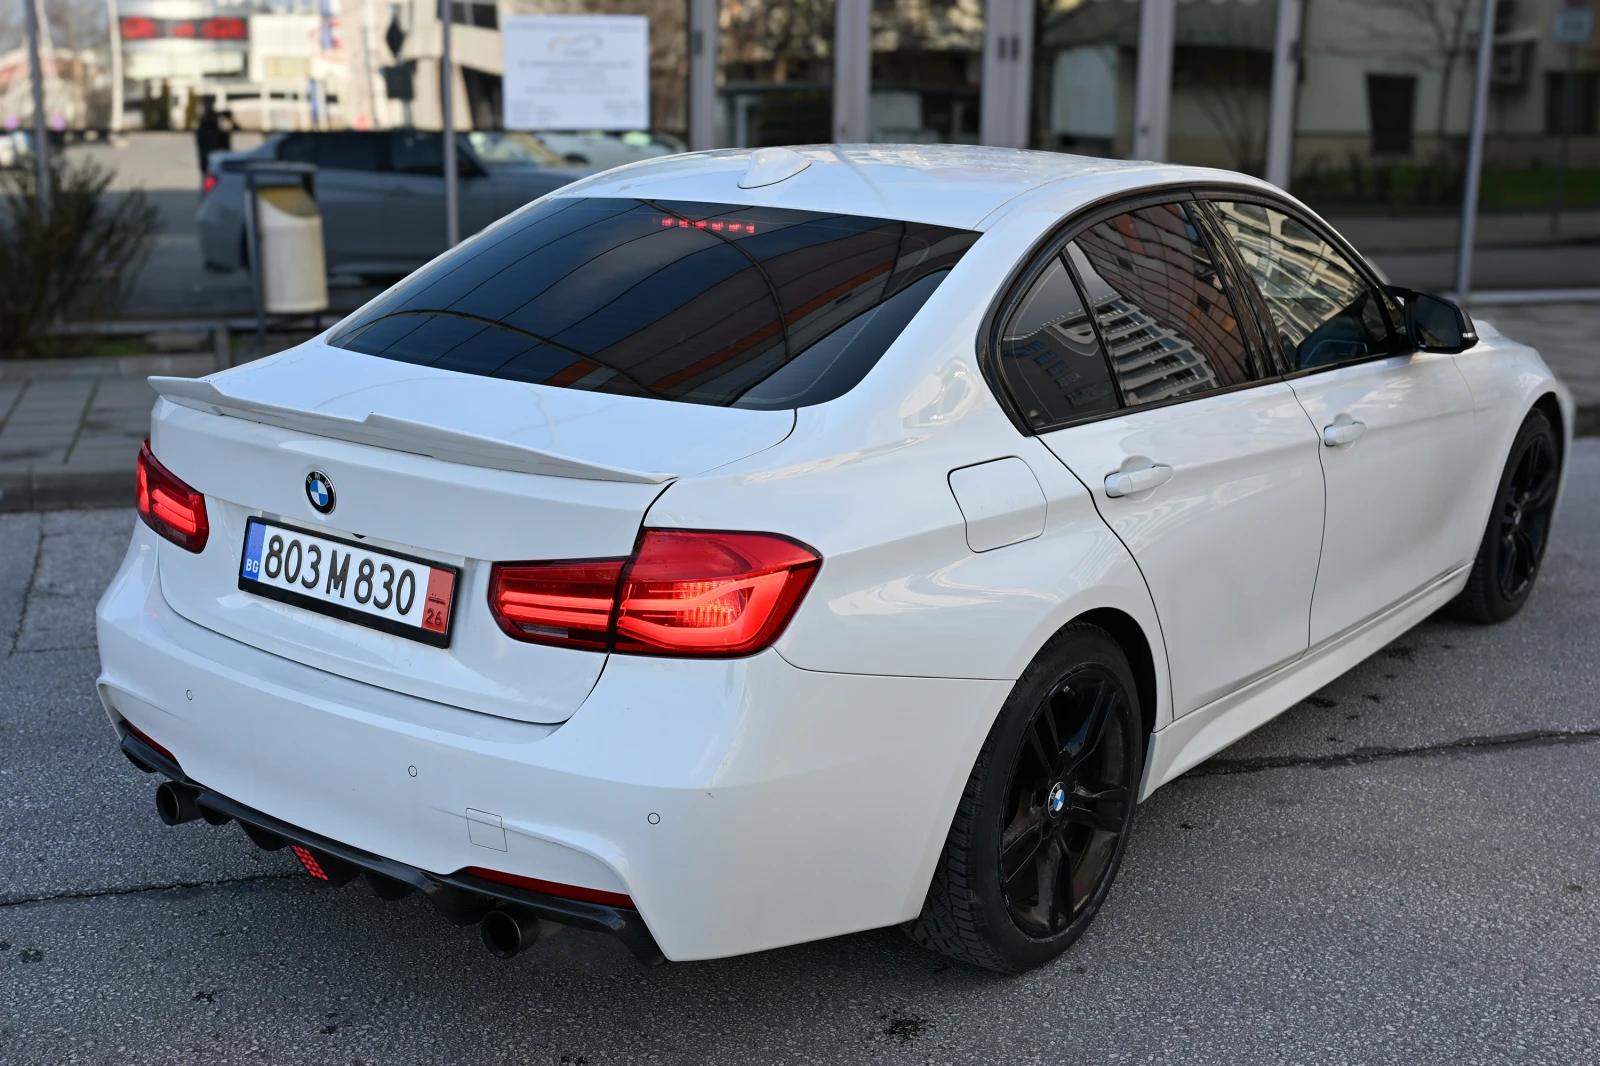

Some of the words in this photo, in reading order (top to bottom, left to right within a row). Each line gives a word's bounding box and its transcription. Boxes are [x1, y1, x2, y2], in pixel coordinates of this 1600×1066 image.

[306, 472, 331, 488] BMW
[246, 558, 259, 573] BG
[264, 534, 322, 589] 803
[325, 549, 351, 598] M
[354, 558, 415, 615] 830
[426, 608, 442, 625] 26
